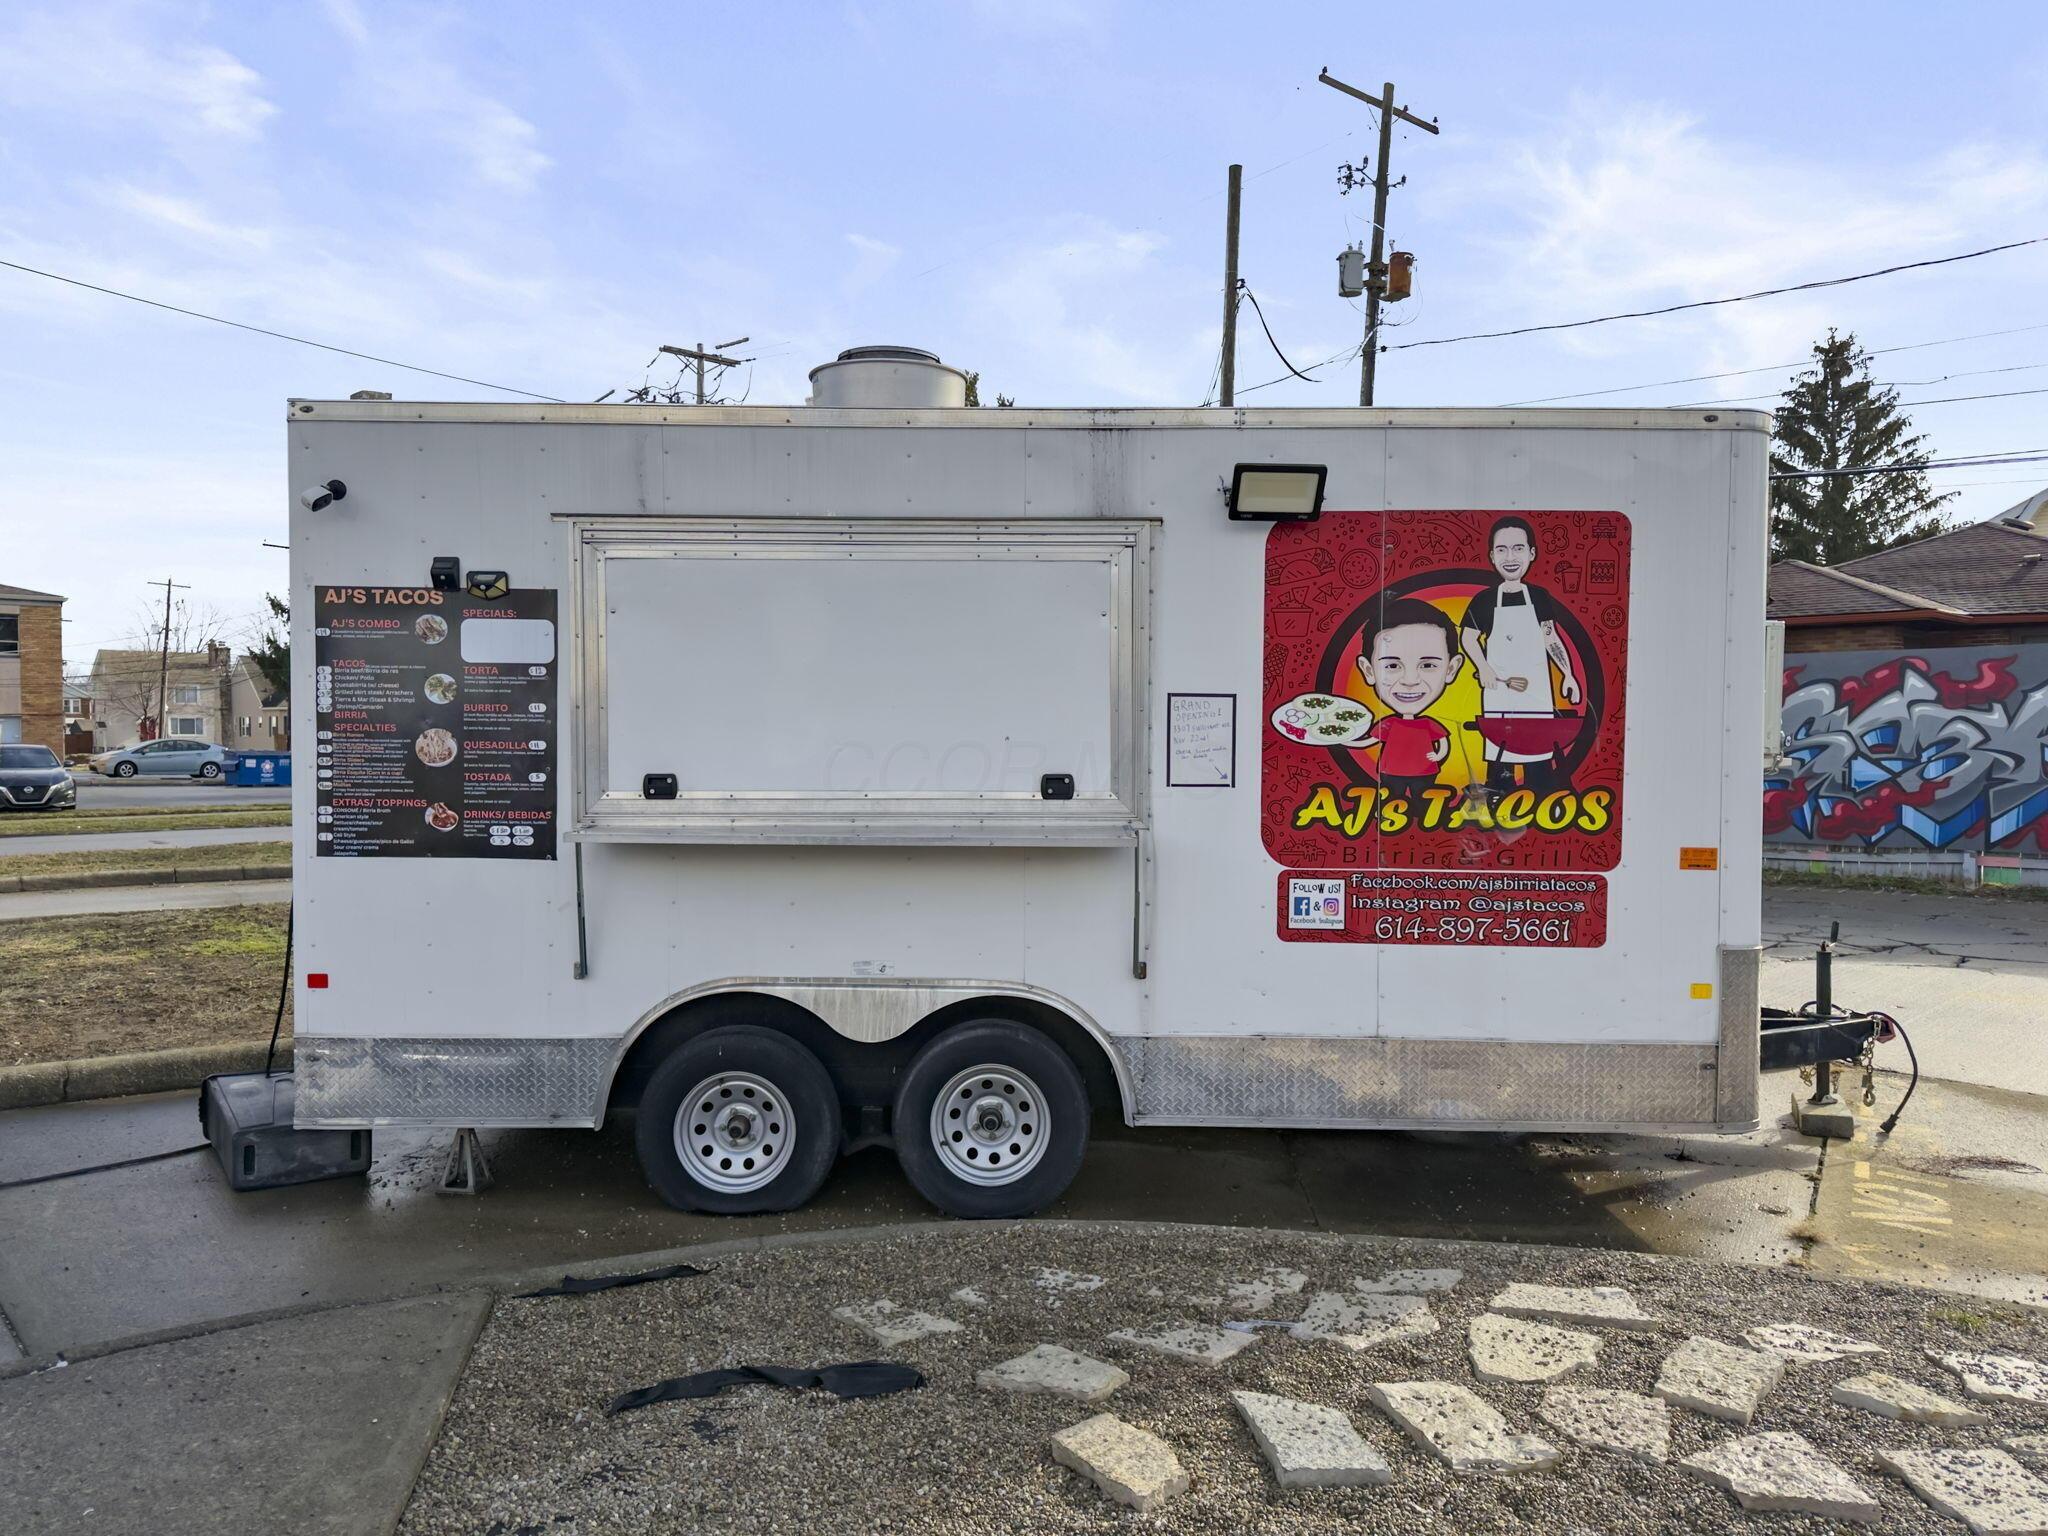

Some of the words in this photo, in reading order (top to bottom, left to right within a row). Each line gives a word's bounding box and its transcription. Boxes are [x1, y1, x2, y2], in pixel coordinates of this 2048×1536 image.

[324, 588, 367, 604] AJ'S
[371, 589, 444, 605] TACOS
[462, 609, 517, 618] SPECIALS:
[331, 618, 355, 628] AJ'S
[357, 619, 401, 628] COMBO
[332, 659, 366, 667] TACOS
[463, 666, 499, 674] TORTA
[463, 703, 509, 712] BURRITO
[1173, 699, 1211, 712] GRAND
[334, 711, 368, 719] BIRRIA
[334, 723, 397, 732] SPECIALTIES
[463, 741, 528, 750] QUESADILLA
[463, 773, 512, 781] TOSTADA
[332, 798, 374, 807] EXTRAS/
[376, 799, 428, 807] TOPPINGS
[463, 810, 505, 819] DRINKS/
[507, 811, 552, 819] BEBIDAS
[1297, 785, 1409, 837] AJ's
[1420, 786, 1612, 832] TACOS
[1342, 845, 1437, 865] Birria
[1495, 846, 1573, 867] Grill
[1350, 873, 1597, 893] Facebook.com/ajsbirriatacos
[1313, 901, 1322, 911] &
[1351, 895, 1461, 913] Instagram
[1468, 896, 1587, 914] @ajstacos
[1374, 915, 1573, 944] 614-897-5661
